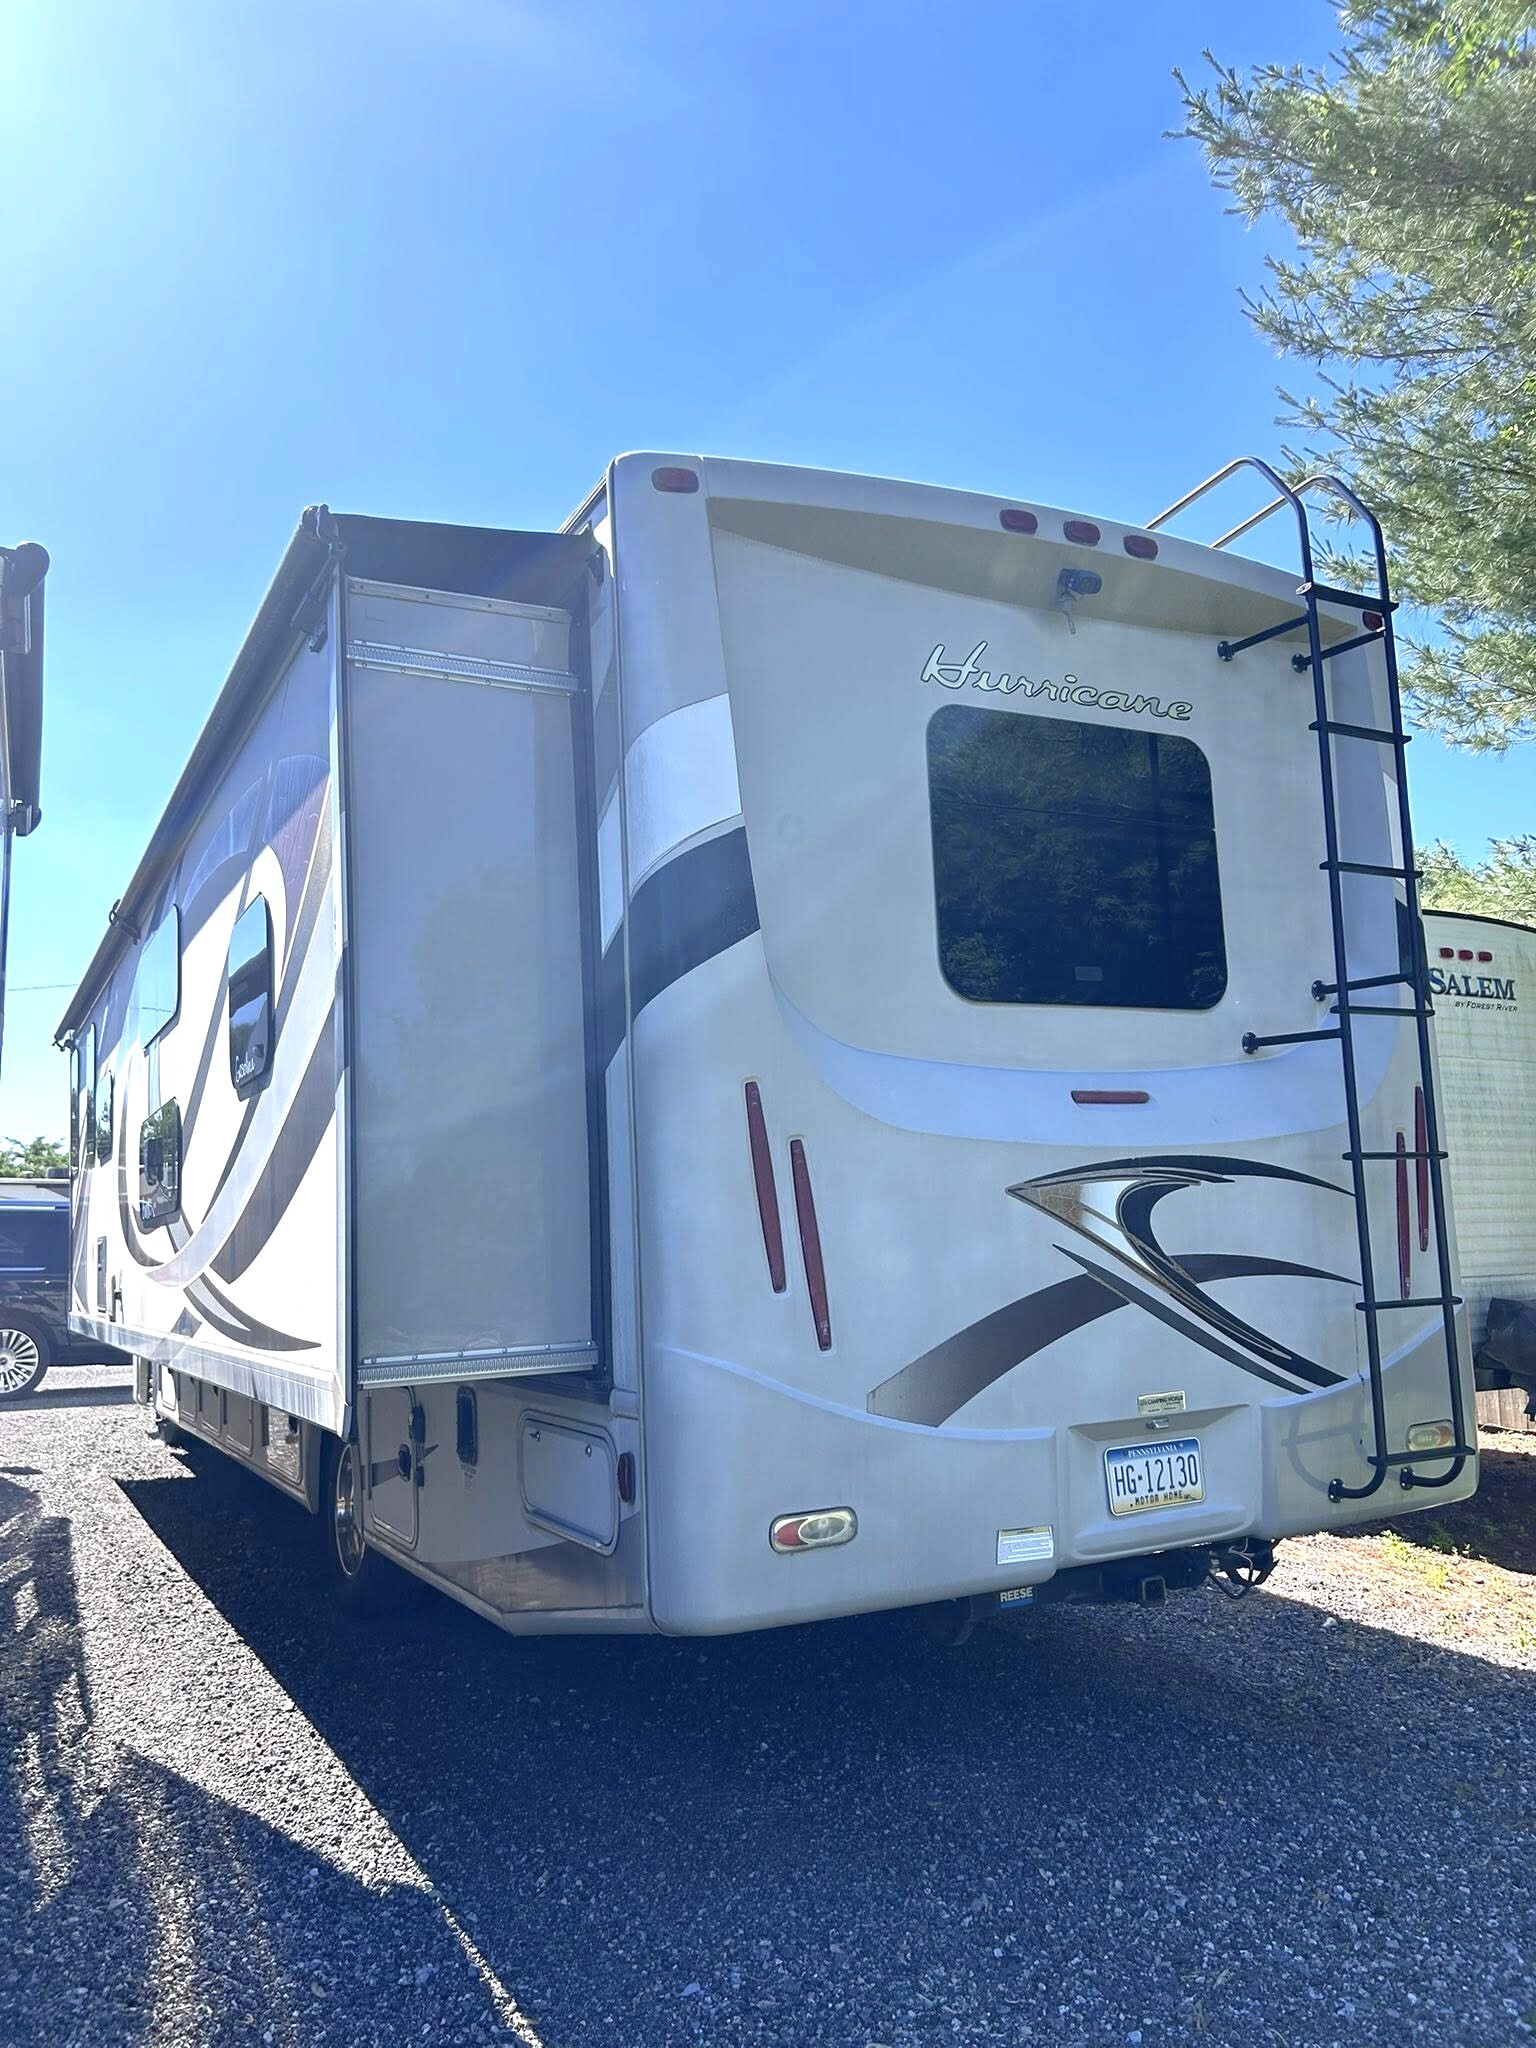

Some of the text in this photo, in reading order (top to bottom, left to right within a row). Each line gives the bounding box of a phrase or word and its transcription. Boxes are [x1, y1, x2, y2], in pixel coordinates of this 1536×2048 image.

[920, 640, 1193, 721] Hurricane
[1428, 967, 1517, 1001] SALEM
[1466, 1001, 1495, 1010] FOREST
[1128, 1444, 1178, 1458] PENNSYLVANIA
[1134, 1490, 1183, 1506] MOTOR HOME
[1000, 1586, 1034, 1603] REESE
